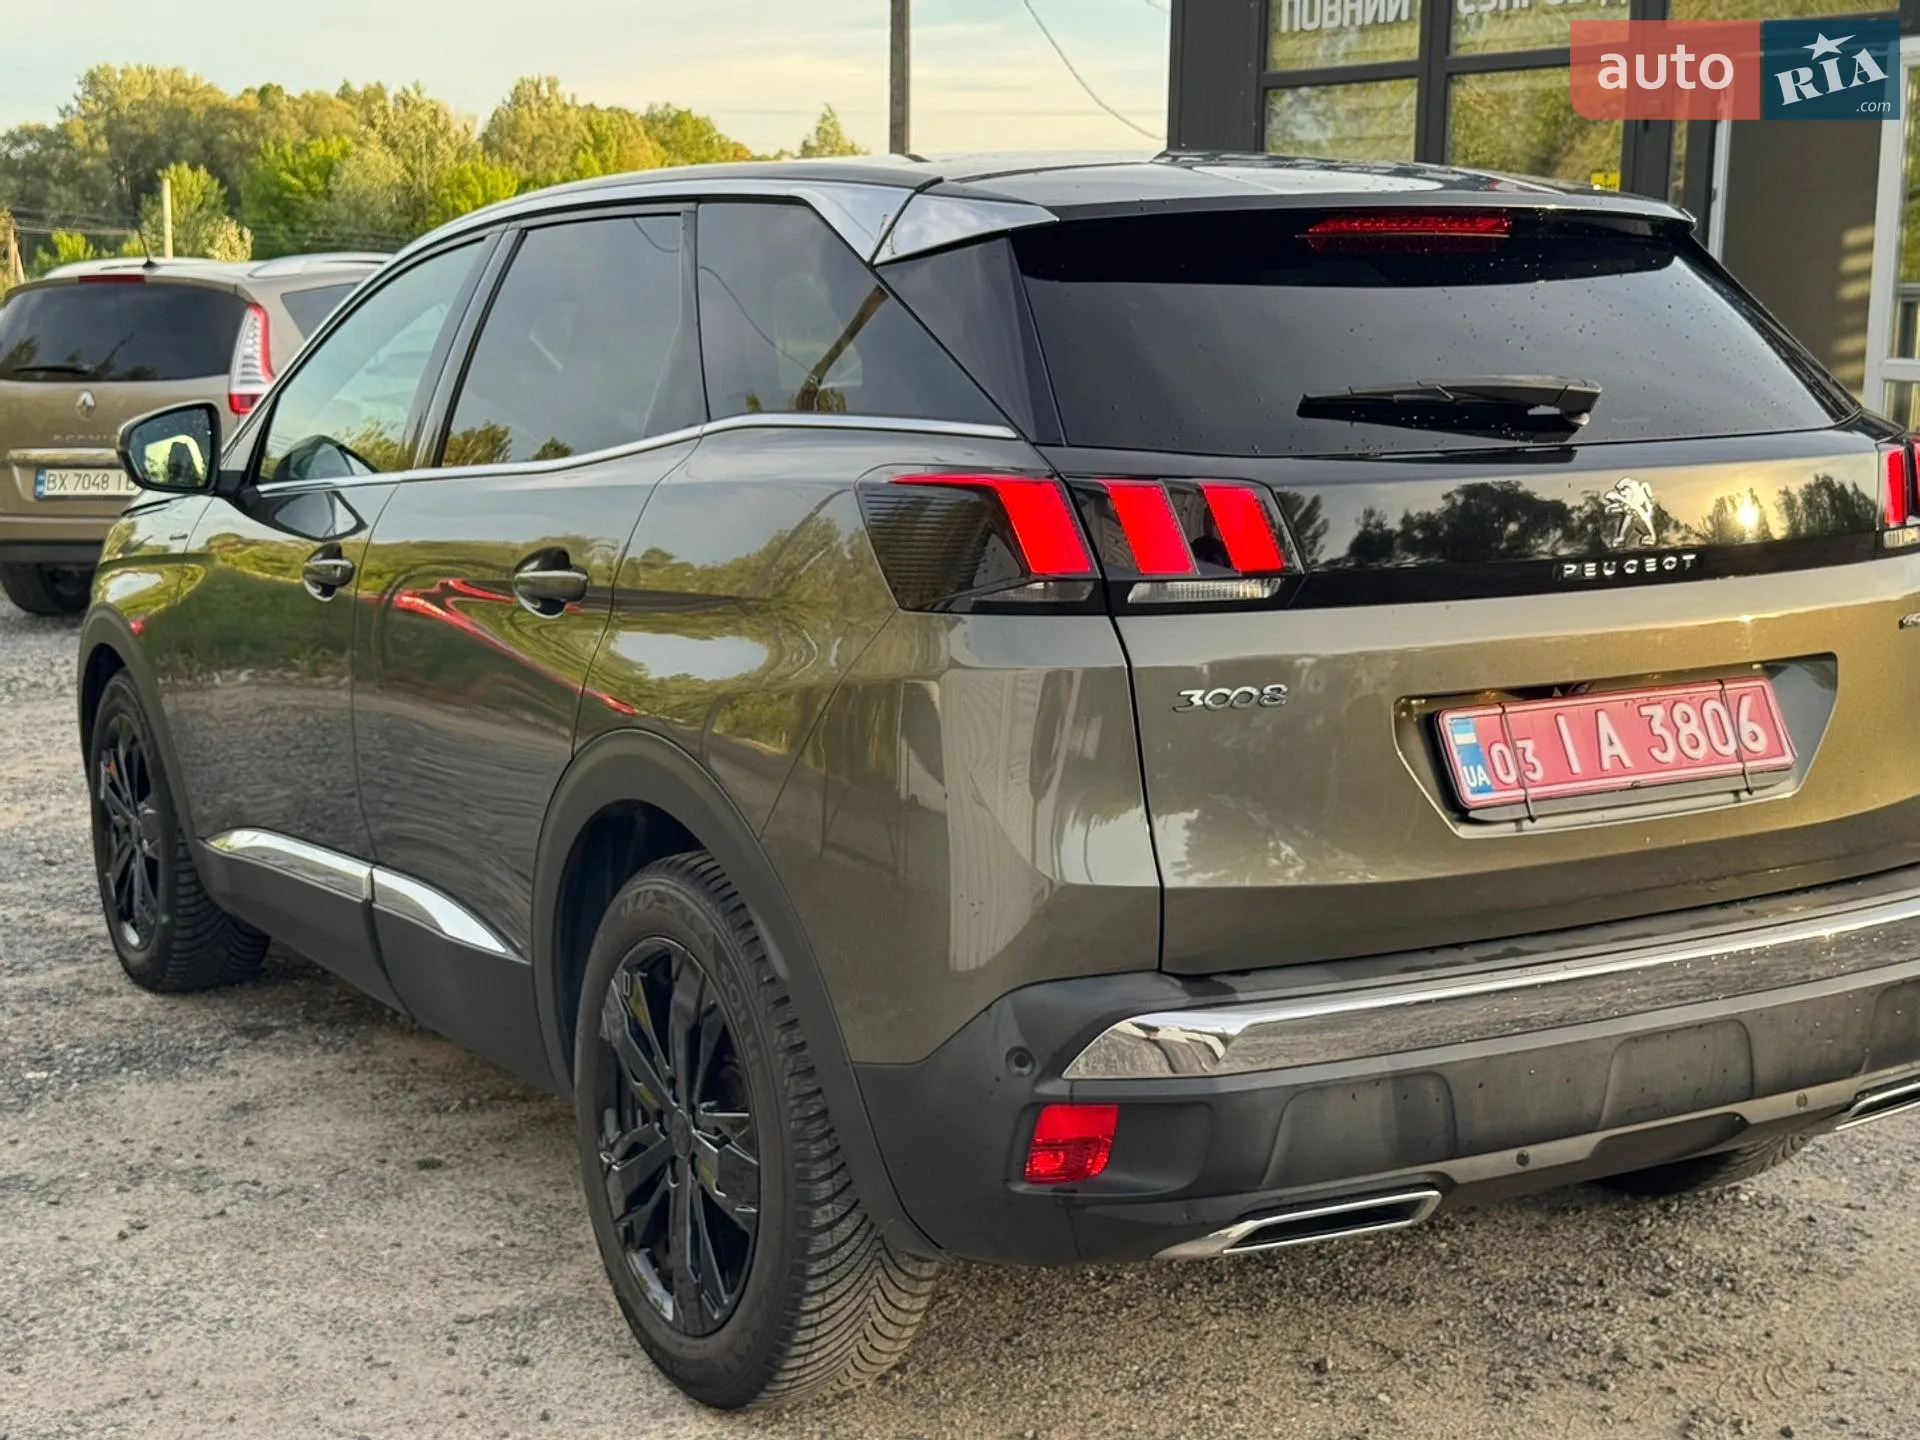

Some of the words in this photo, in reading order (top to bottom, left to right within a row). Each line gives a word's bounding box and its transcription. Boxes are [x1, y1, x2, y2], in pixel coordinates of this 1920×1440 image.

[46, 473, 68, 491] BX
[73, 473, 109, 491] 7048
[1562, 553, 1697, 578] PEUGEOT
[1172, 684, 1288, 713] 3008
[1488, 738, 1544, 785] 03
[1639, 693, 1768, 765] 3806
[1462, 764, 1490, 787] UA
